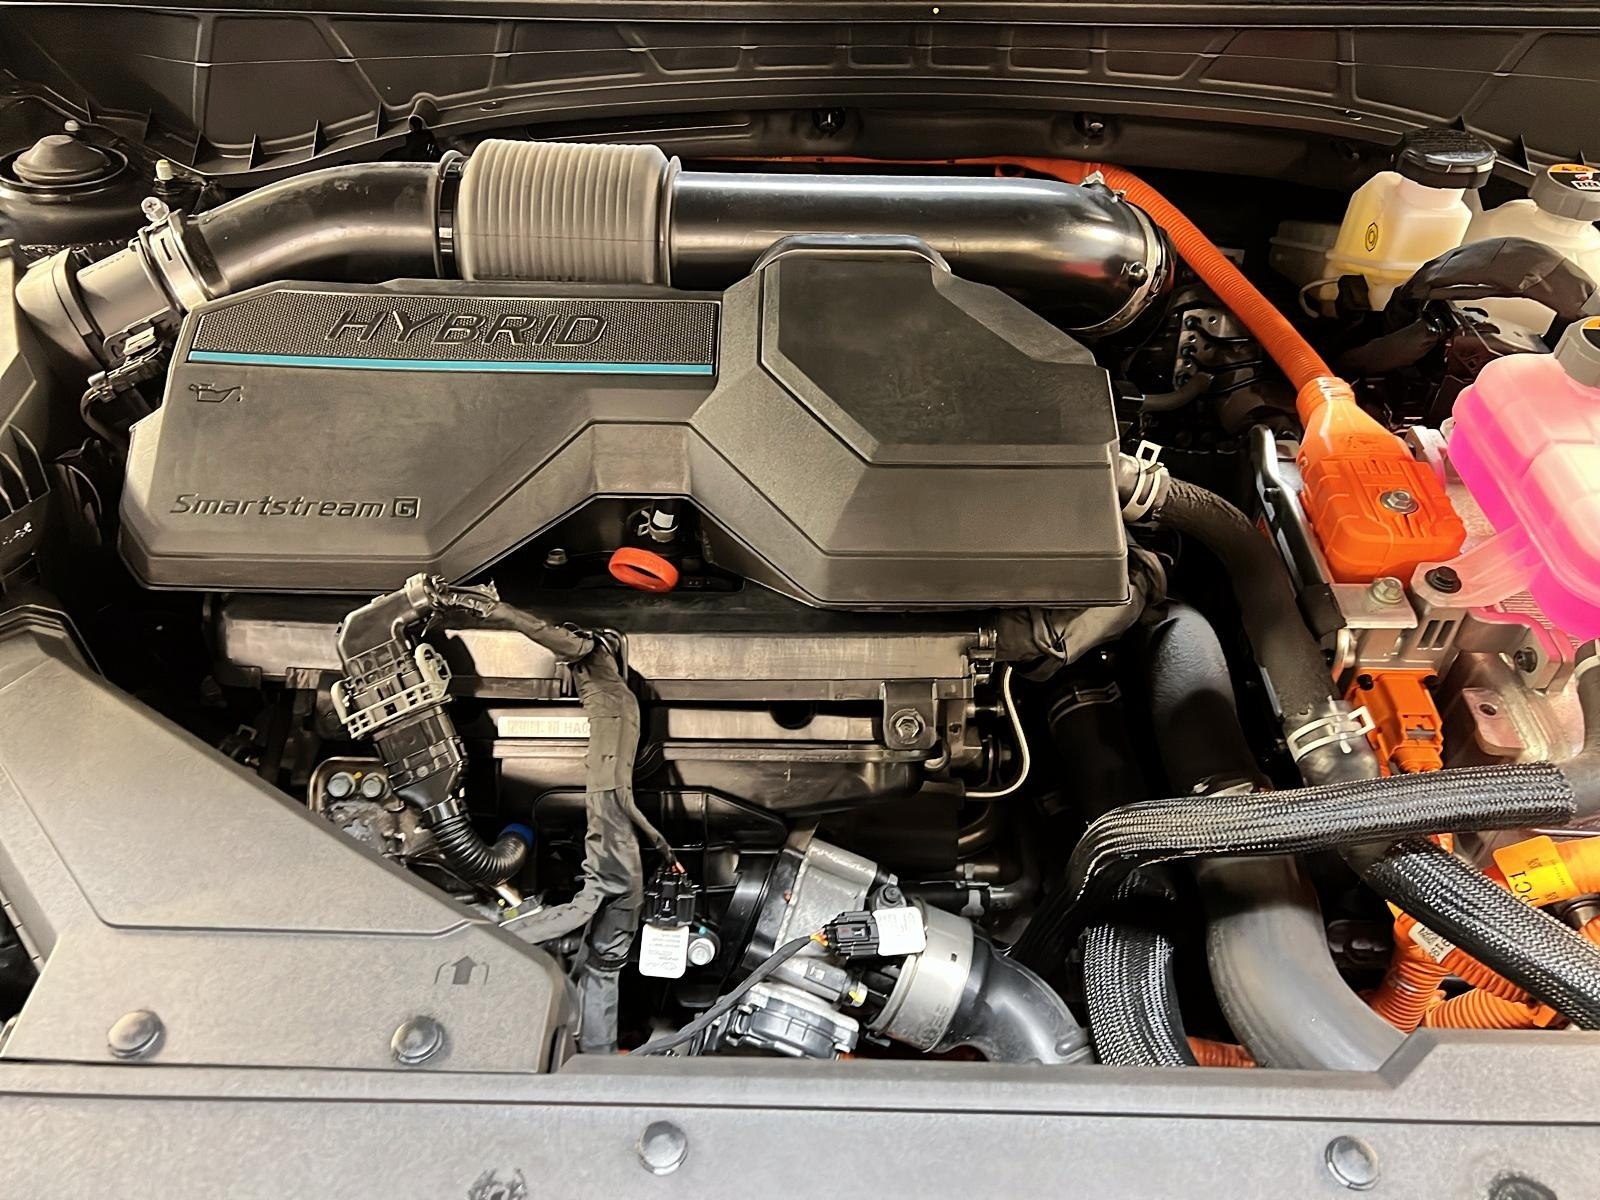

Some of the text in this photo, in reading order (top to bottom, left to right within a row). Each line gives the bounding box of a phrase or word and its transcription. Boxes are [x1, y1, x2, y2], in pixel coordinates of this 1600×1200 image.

[325, 309, 608, 347] HYBRID
[170, 493, 421, 518] Smartstream G
